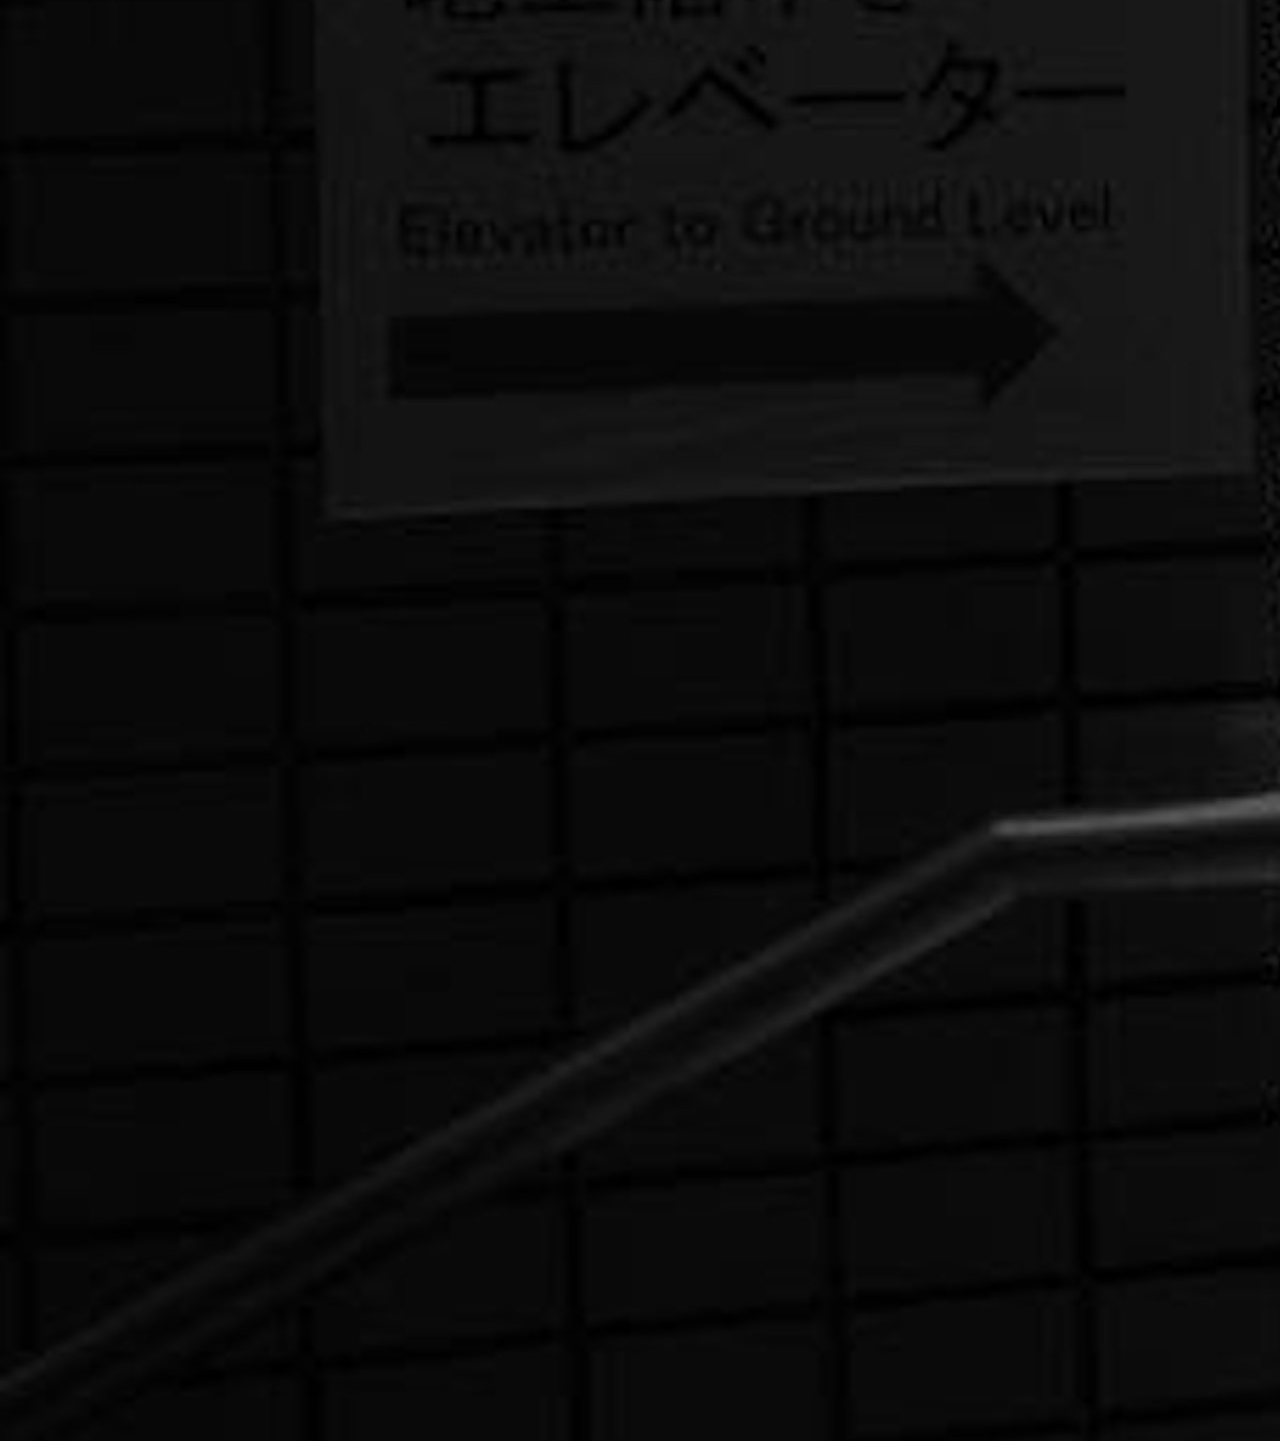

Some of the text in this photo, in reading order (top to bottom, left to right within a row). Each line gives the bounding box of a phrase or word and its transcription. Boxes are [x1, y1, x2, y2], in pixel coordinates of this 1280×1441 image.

[425, 42, 1126, 151] エレベーター
[398, 180, 1117, 258] Elevator to Ground Level
